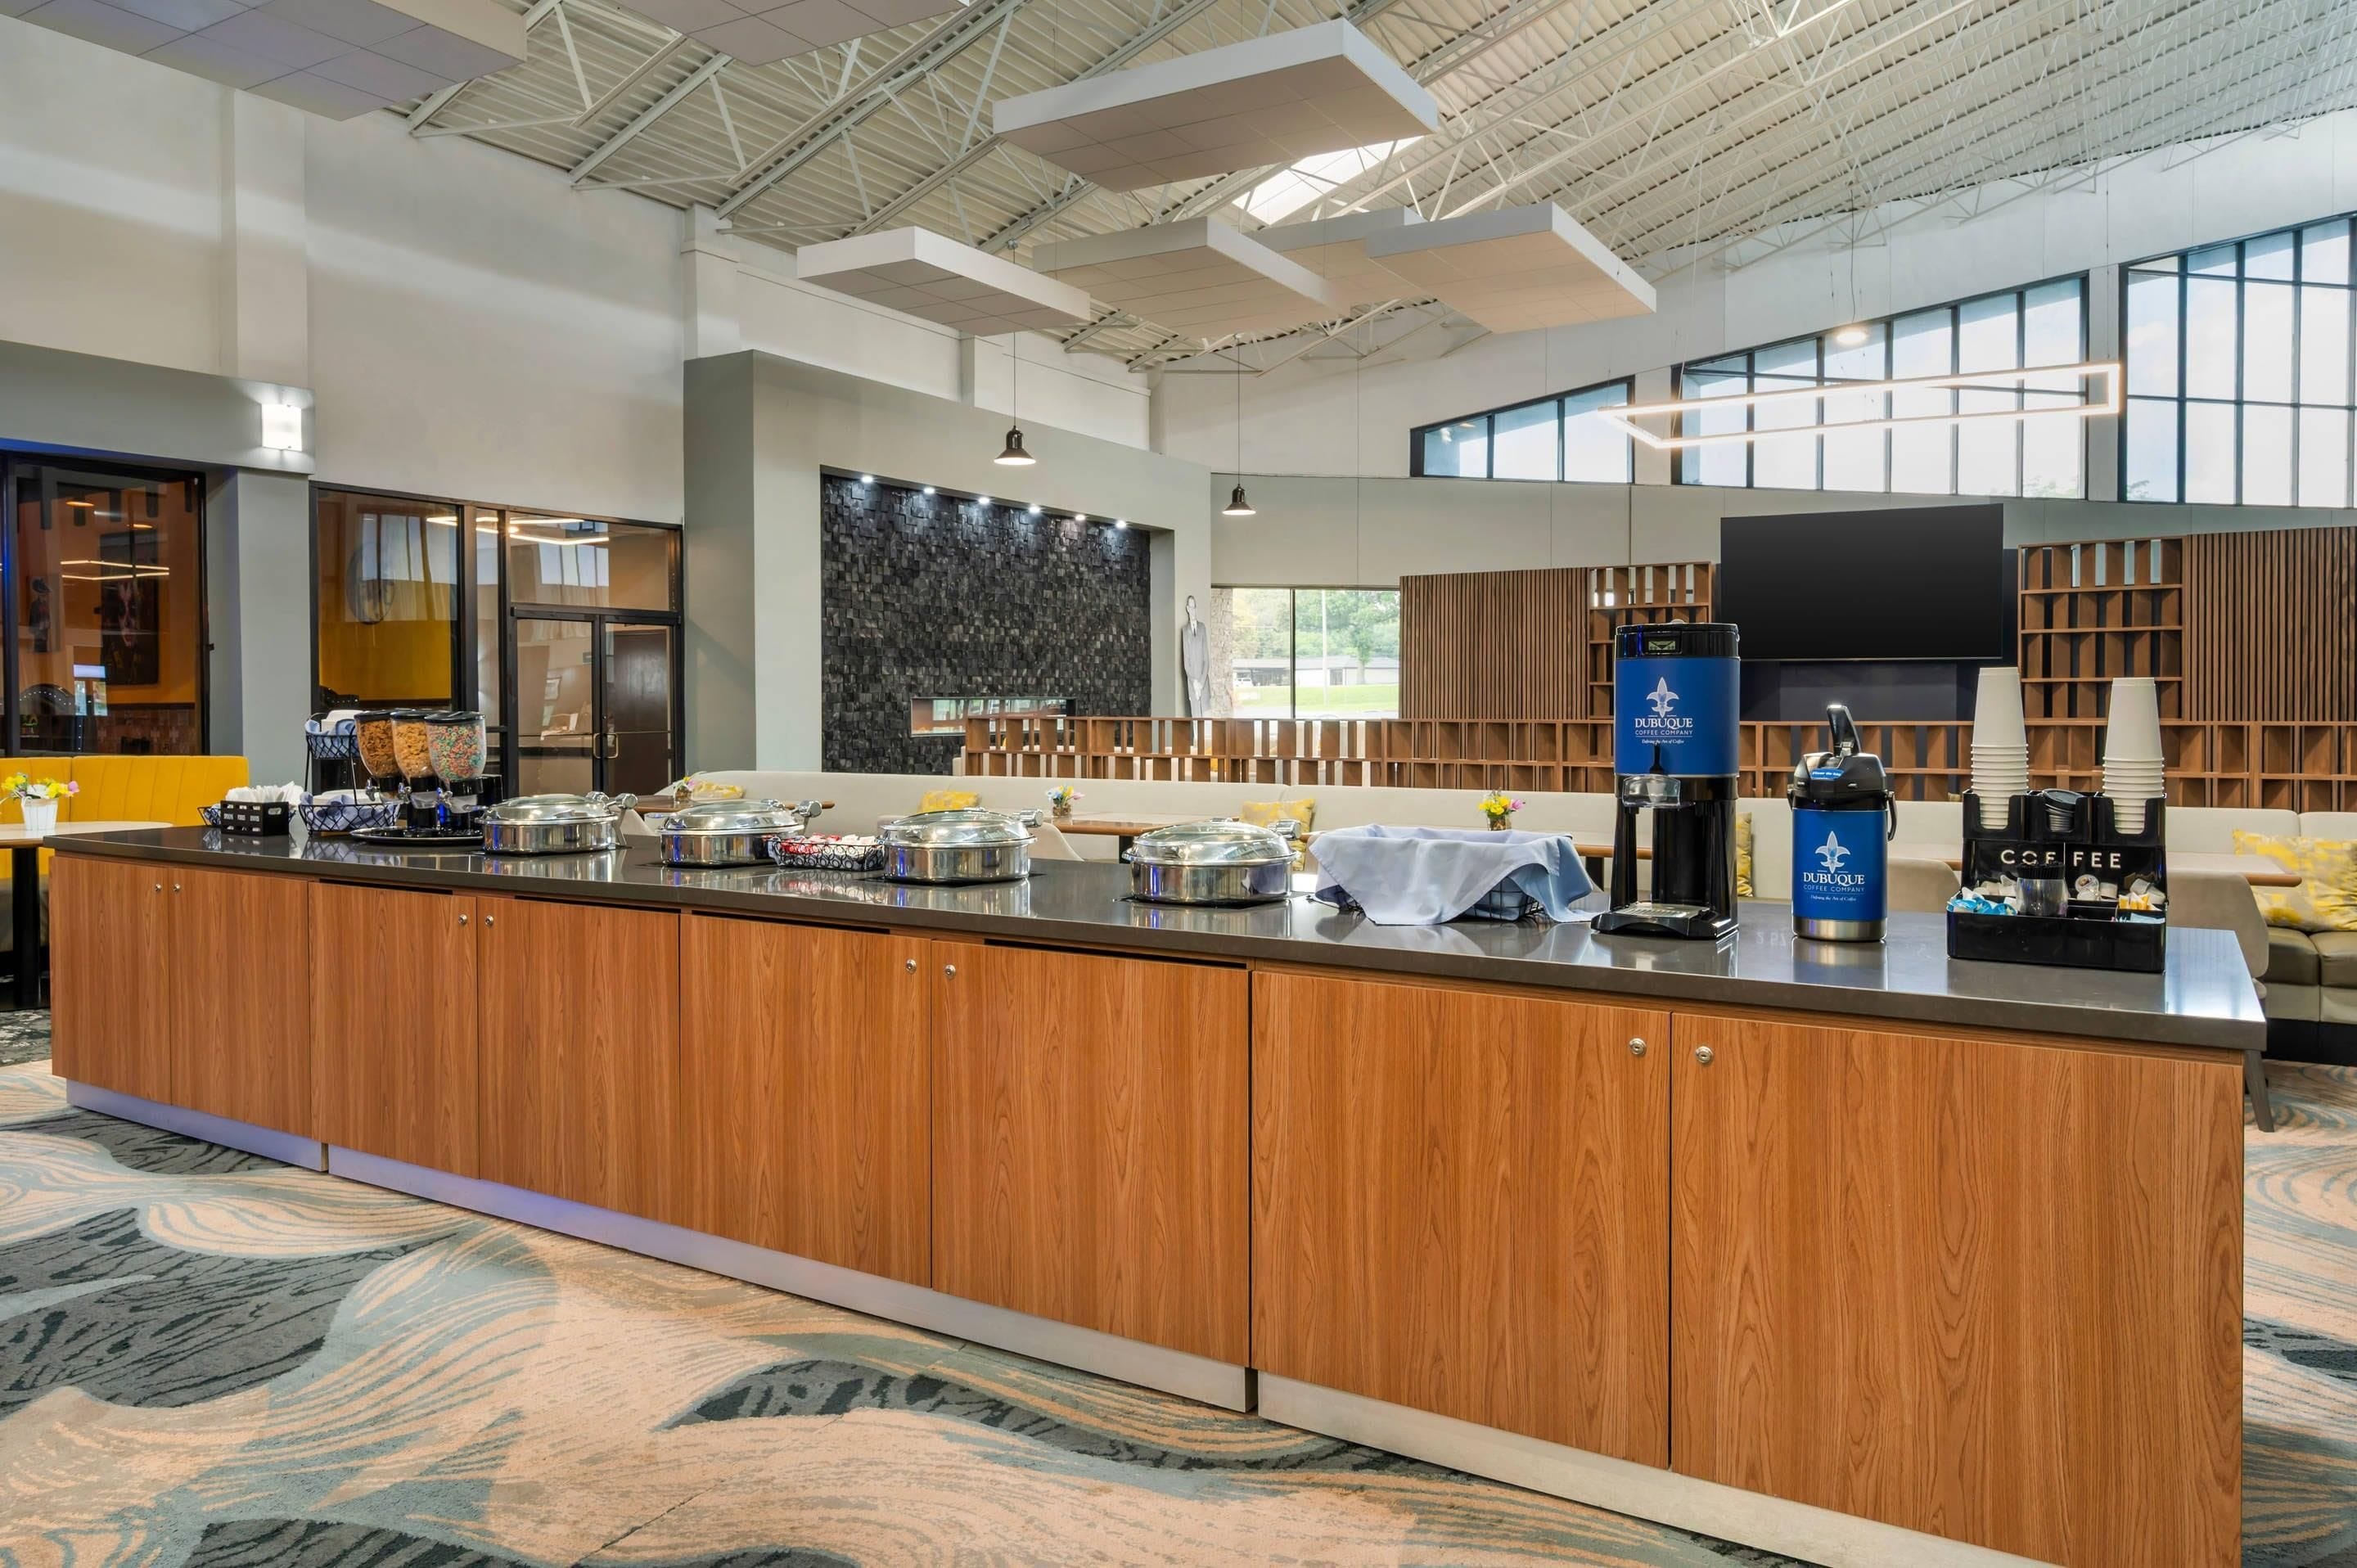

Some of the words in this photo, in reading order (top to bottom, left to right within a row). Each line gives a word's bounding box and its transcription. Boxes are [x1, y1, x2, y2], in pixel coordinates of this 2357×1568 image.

[1634, 718, 1693, 729] DUBUQUE
[2000, 849, 2121, 869] COFFEE
[1803, 872, 1865, 886] DUBUQUE
